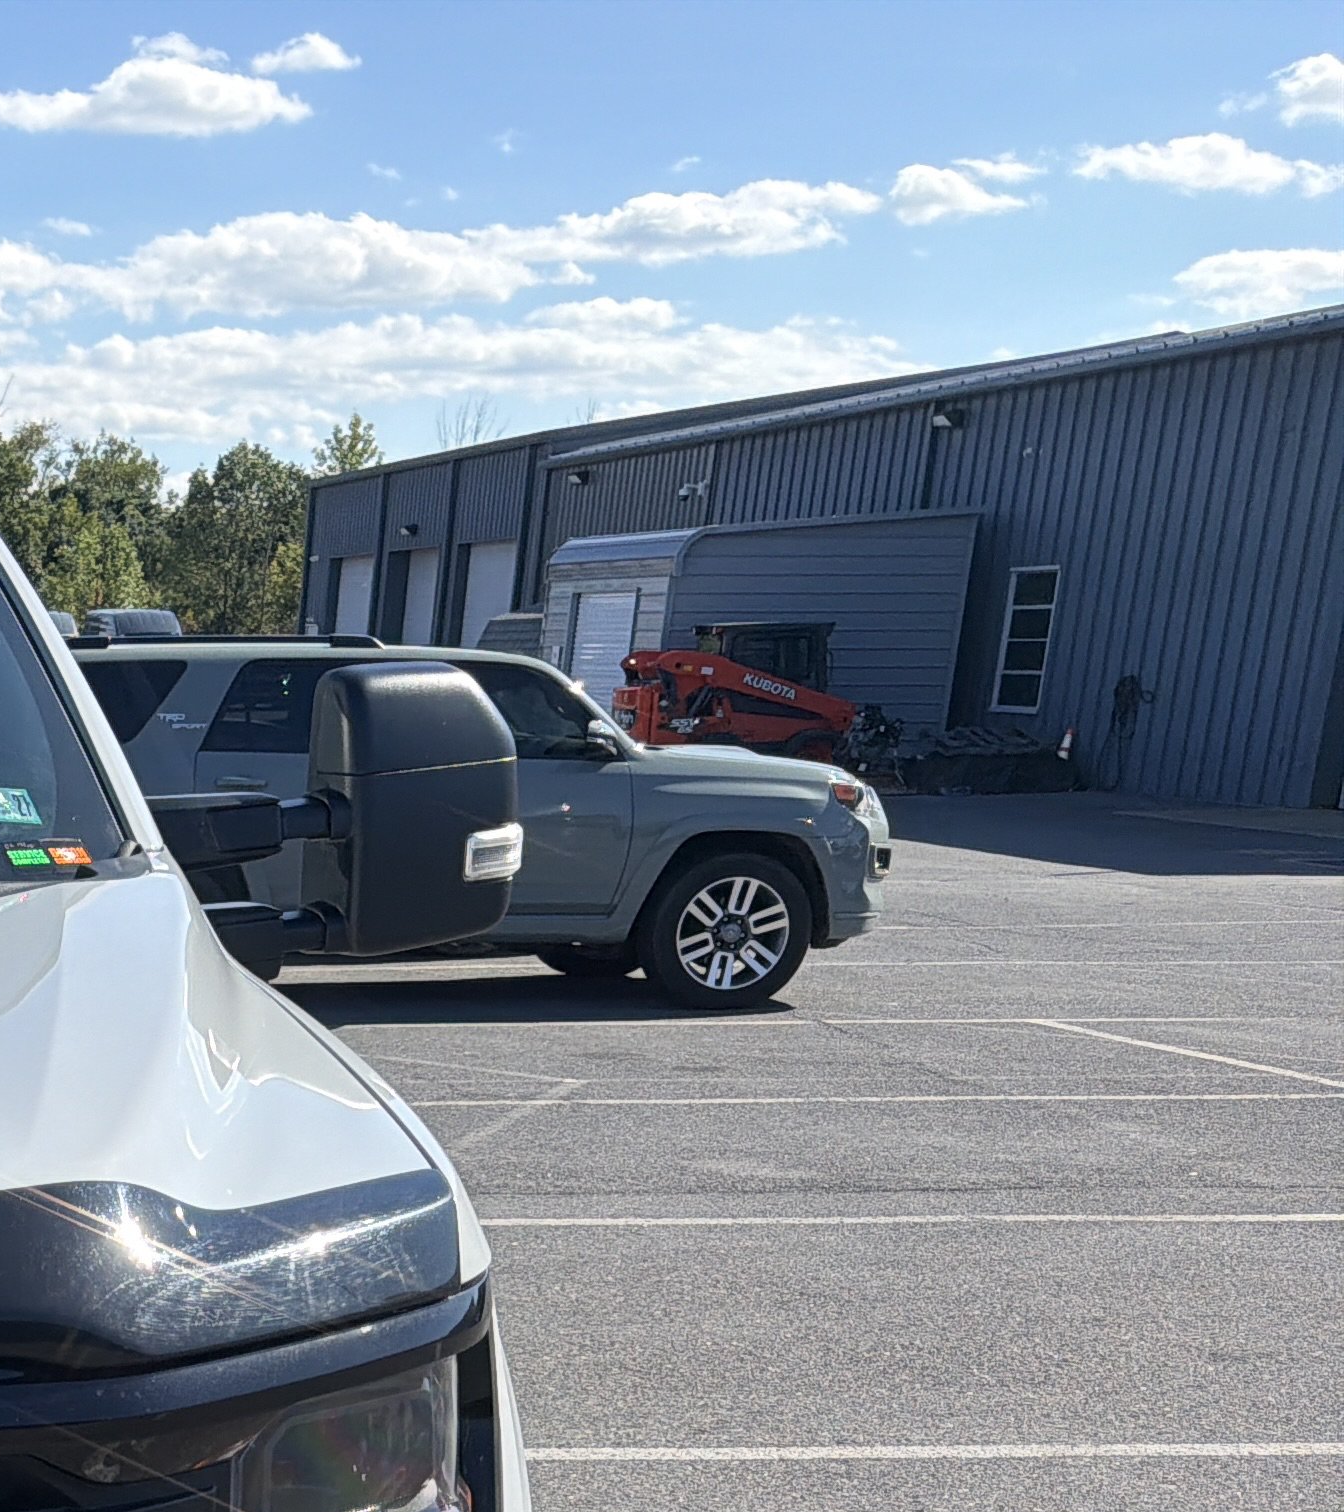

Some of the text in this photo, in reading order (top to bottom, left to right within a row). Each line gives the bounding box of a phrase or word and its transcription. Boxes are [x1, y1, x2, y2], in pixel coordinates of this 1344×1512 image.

[742, 673, 796, 701] KUBOTA
[156, 713, 186, 722] TRD
[10, 793, 32, 817] 27
